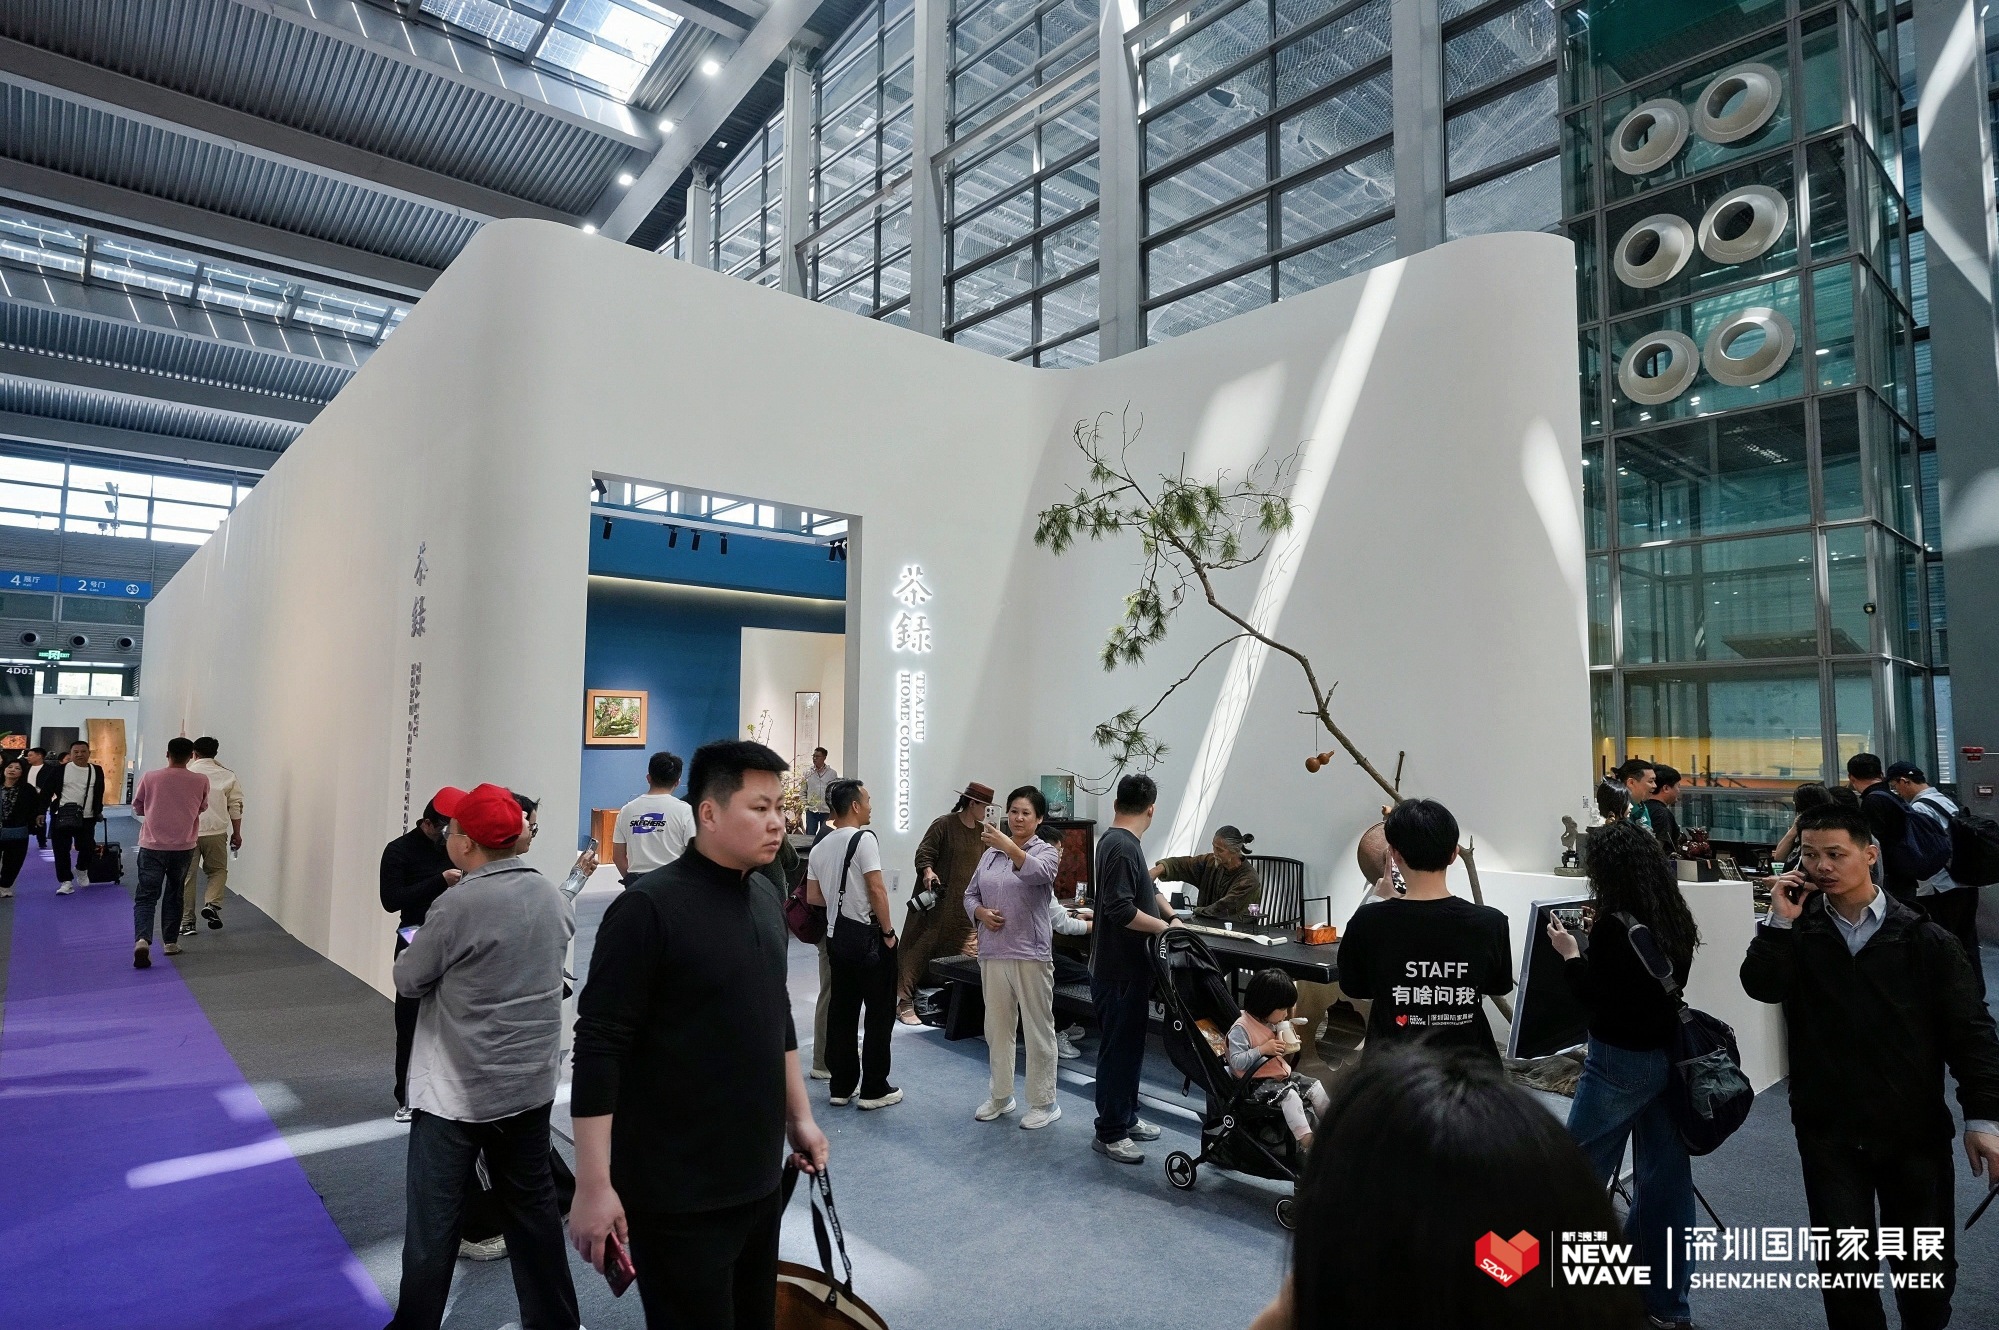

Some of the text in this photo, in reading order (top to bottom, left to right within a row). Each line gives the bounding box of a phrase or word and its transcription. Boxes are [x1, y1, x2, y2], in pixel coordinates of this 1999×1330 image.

[10, 574, 40, 586] 4 展厅
[77, 579, 87, 591] 2
[6, 667, 34, 675] 4D01
[914, 673, 926, 741] TEA LUU
[899, 673, 911, 831] HOME COLLECTION
[1405, 961, 1469, 979] STAFF
